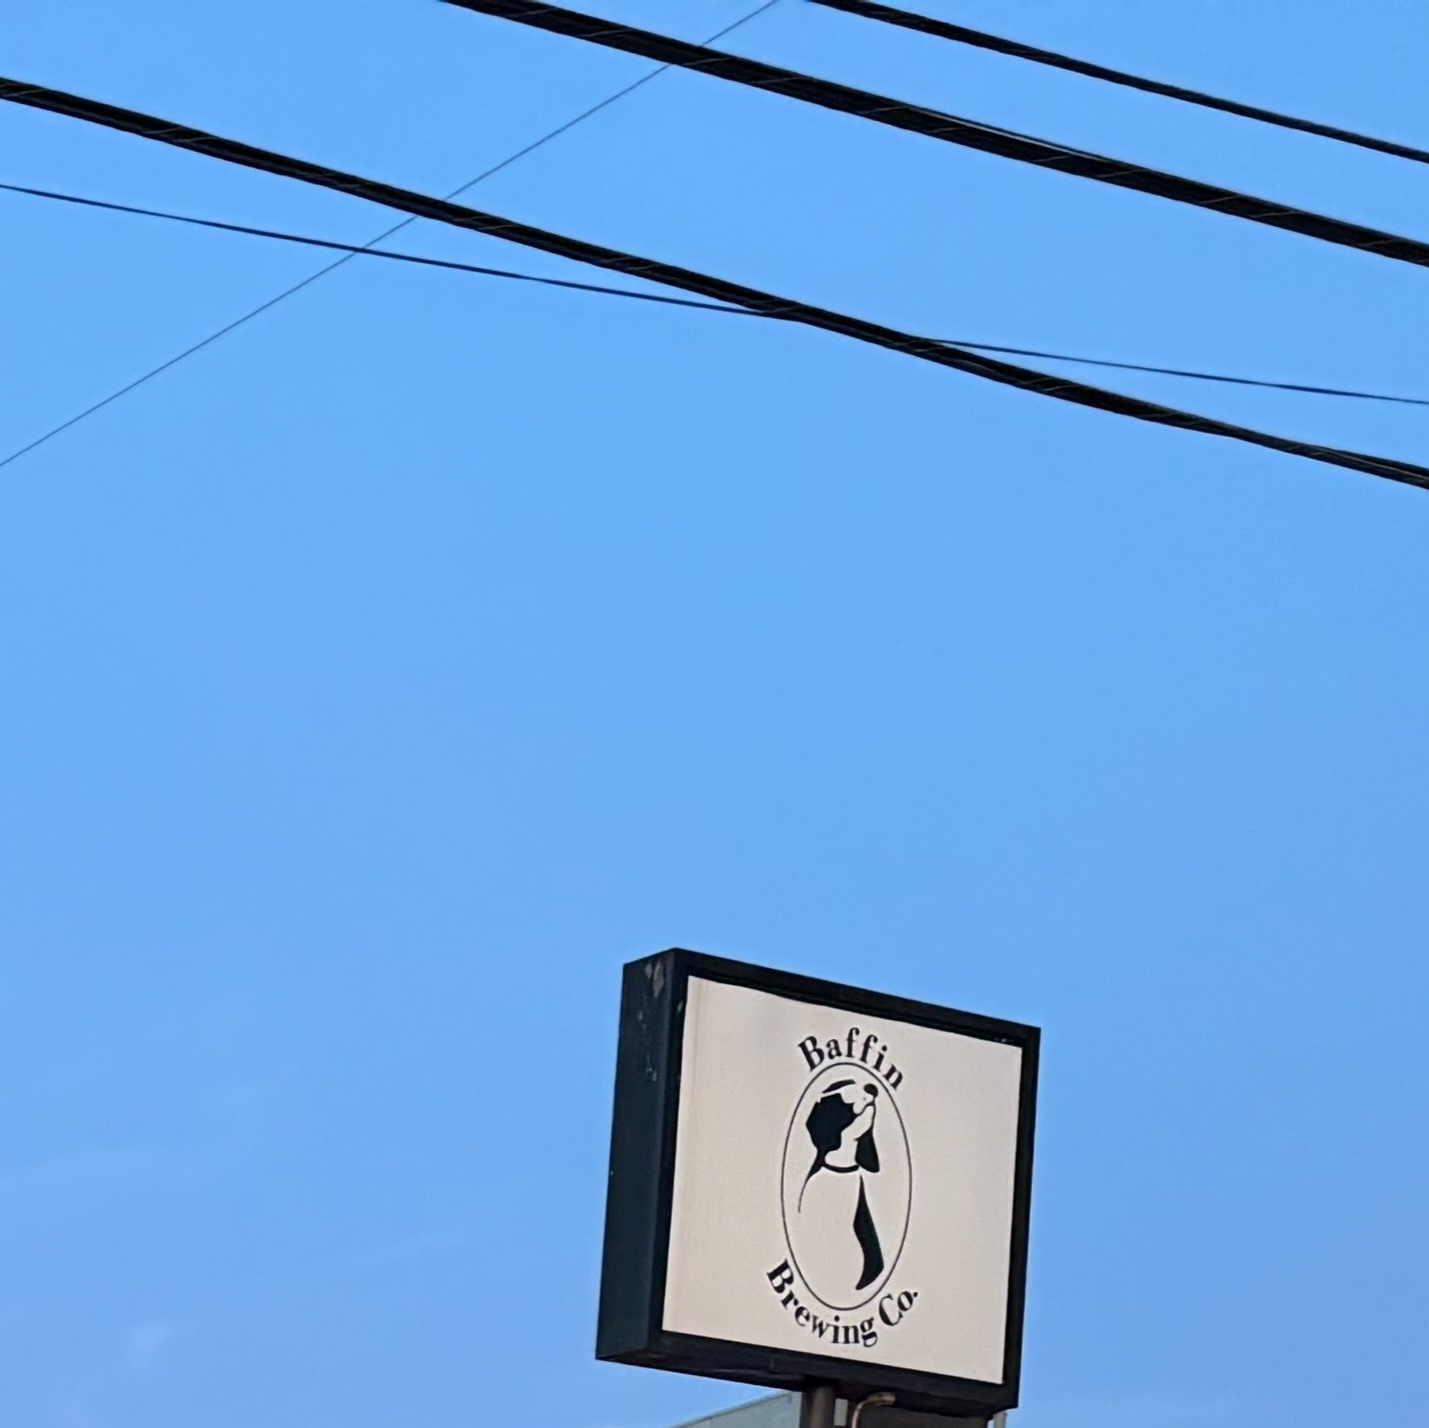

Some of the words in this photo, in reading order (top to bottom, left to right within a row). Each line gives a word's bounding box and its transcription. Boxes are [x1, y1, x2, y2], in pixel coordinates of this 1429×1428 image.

[797, 1026, 904, 1091] Baffin
[766, 1258, 878, 1348] Brewing
[879, 1290, 919, 1327] Co.
